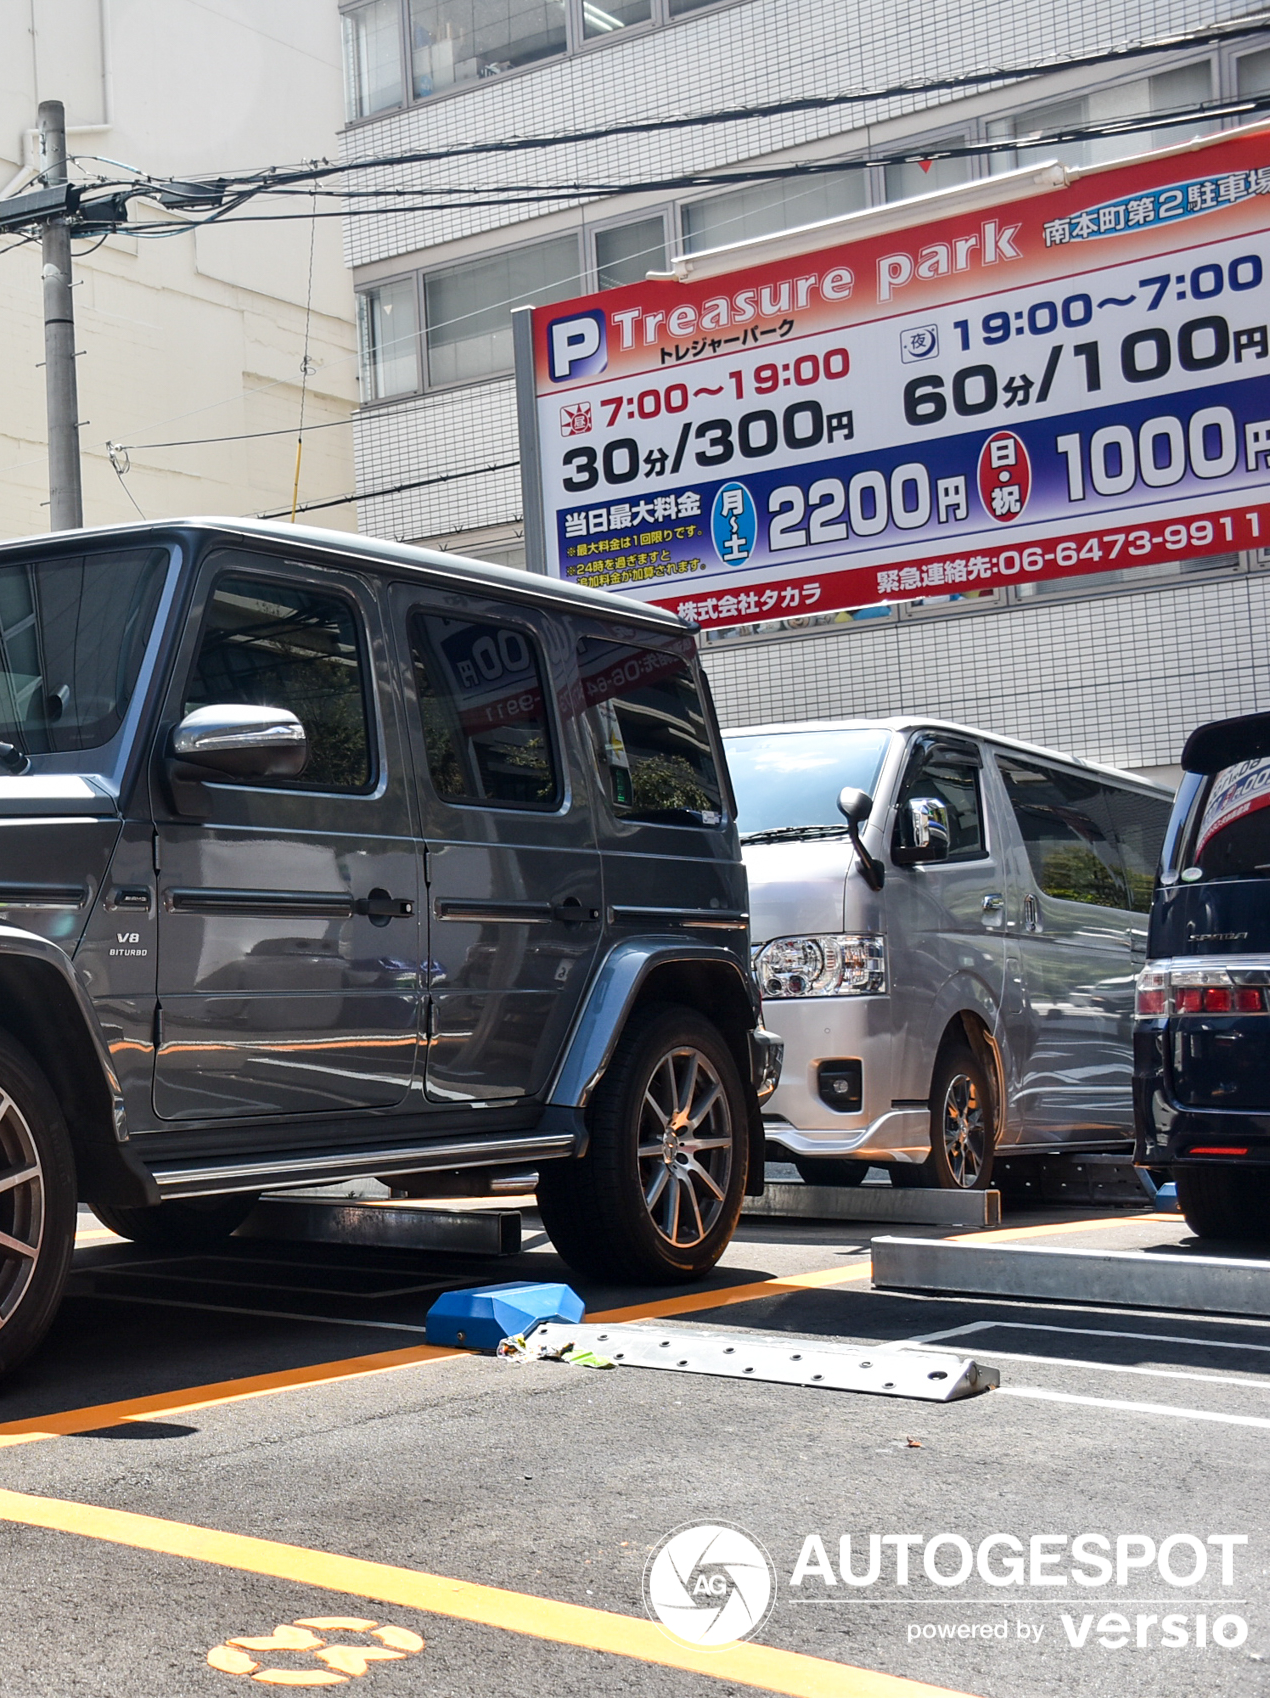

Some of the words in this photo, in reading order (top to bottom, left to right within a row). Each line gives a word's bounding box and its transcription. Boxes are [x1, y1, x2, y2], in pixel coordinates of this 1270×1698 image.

[612, 267, 855, 352] Treasure
[876, 219, 1023, 304] park
[660, 318, 795, 365] トレジャーパーク
[910, 333, 927, 351] 夜
[903, 315, 1269, 427] 60分/100円
[562, 400, 855, 493] 30分/300円
[564, 491, 702, 538] 当日最大料金
[767, 462, 968, 552] 2200円
[677, 582, 821, 624] 株式会社タカラ
[109, 948, 148, 956] BITURBO
[116, 932, 140, 943] V8
